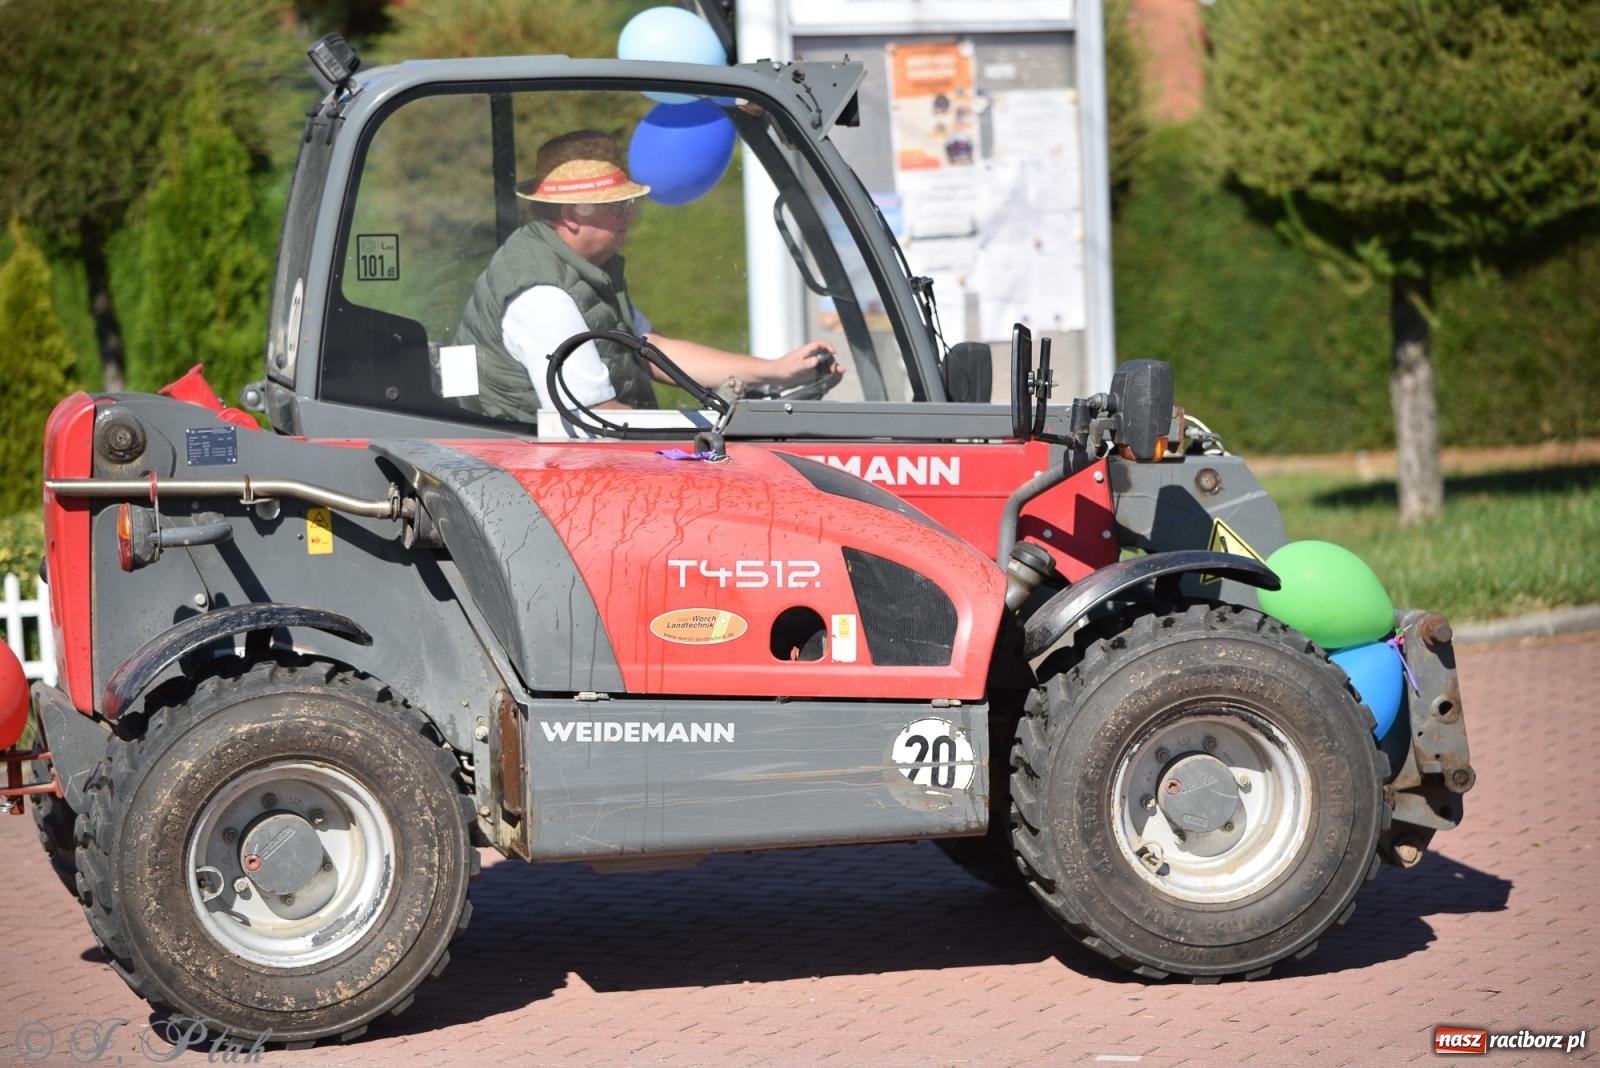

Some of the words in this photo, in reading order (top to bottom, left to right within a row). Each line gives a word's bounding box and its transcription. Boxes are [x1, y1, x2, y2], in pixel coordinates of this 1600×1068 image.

[361, 254, 384, 277] 101
[806, 456, 960, 485] MANN
[666, 621, 715, 629] Landtechnik
[540, 721, 735, 743] WEIDEMANN
[905, 735, 957, 788] 20
